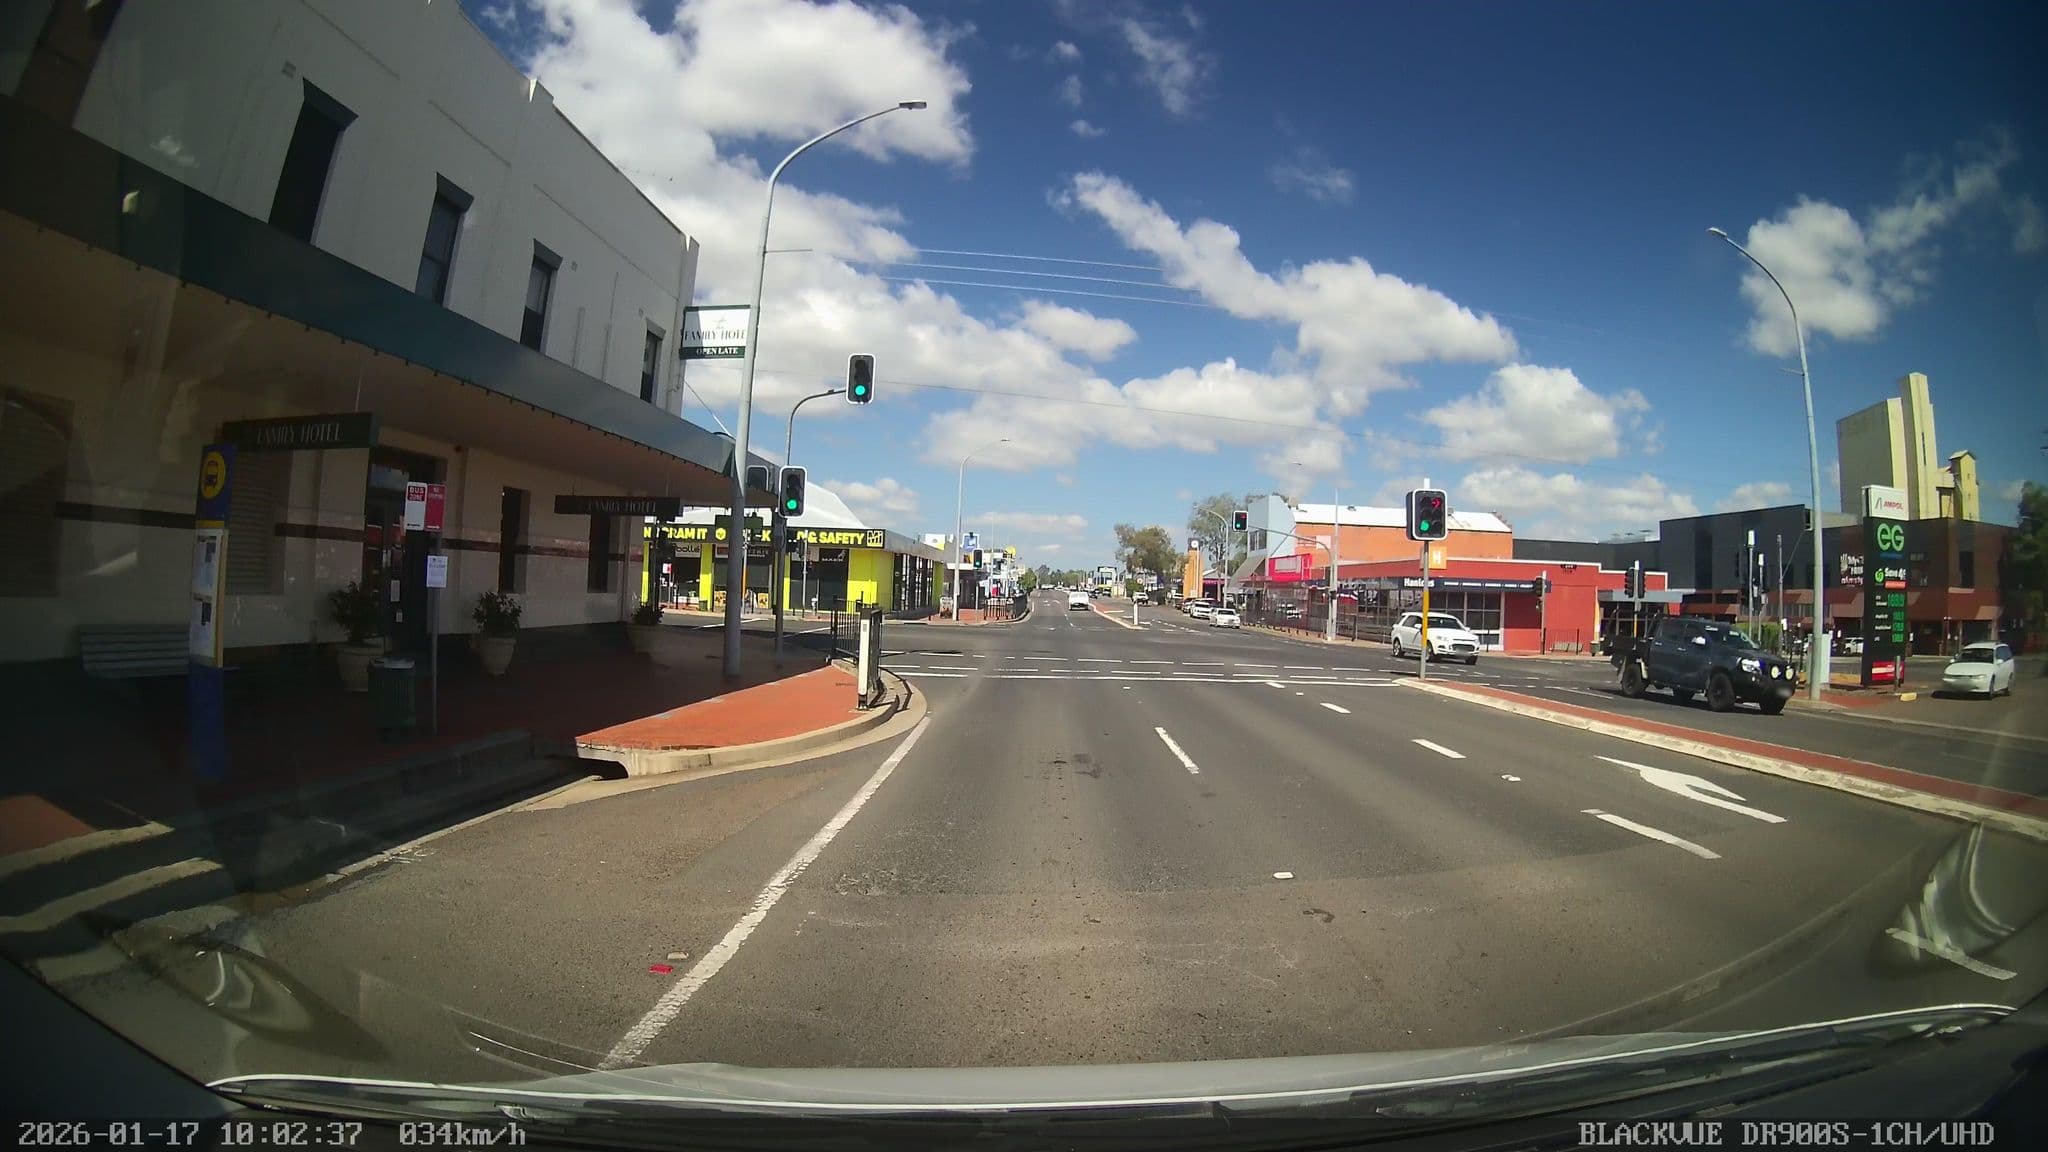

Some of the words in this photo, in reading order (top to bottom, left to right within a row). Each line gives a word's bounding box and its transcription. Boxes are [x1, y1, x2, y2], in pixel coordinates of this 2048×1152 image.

[684, 330, 716, 340] FAMILY
[721, 329, 745, 340] HOTE
[697, 346, 717, 355] OPEN
[256, 424, 295, 446] FAMILY
[300, 423, 341, 443] HOTEL
[808, 531, 818, 544] &
[819, 531, 865, 545] SAFETY
